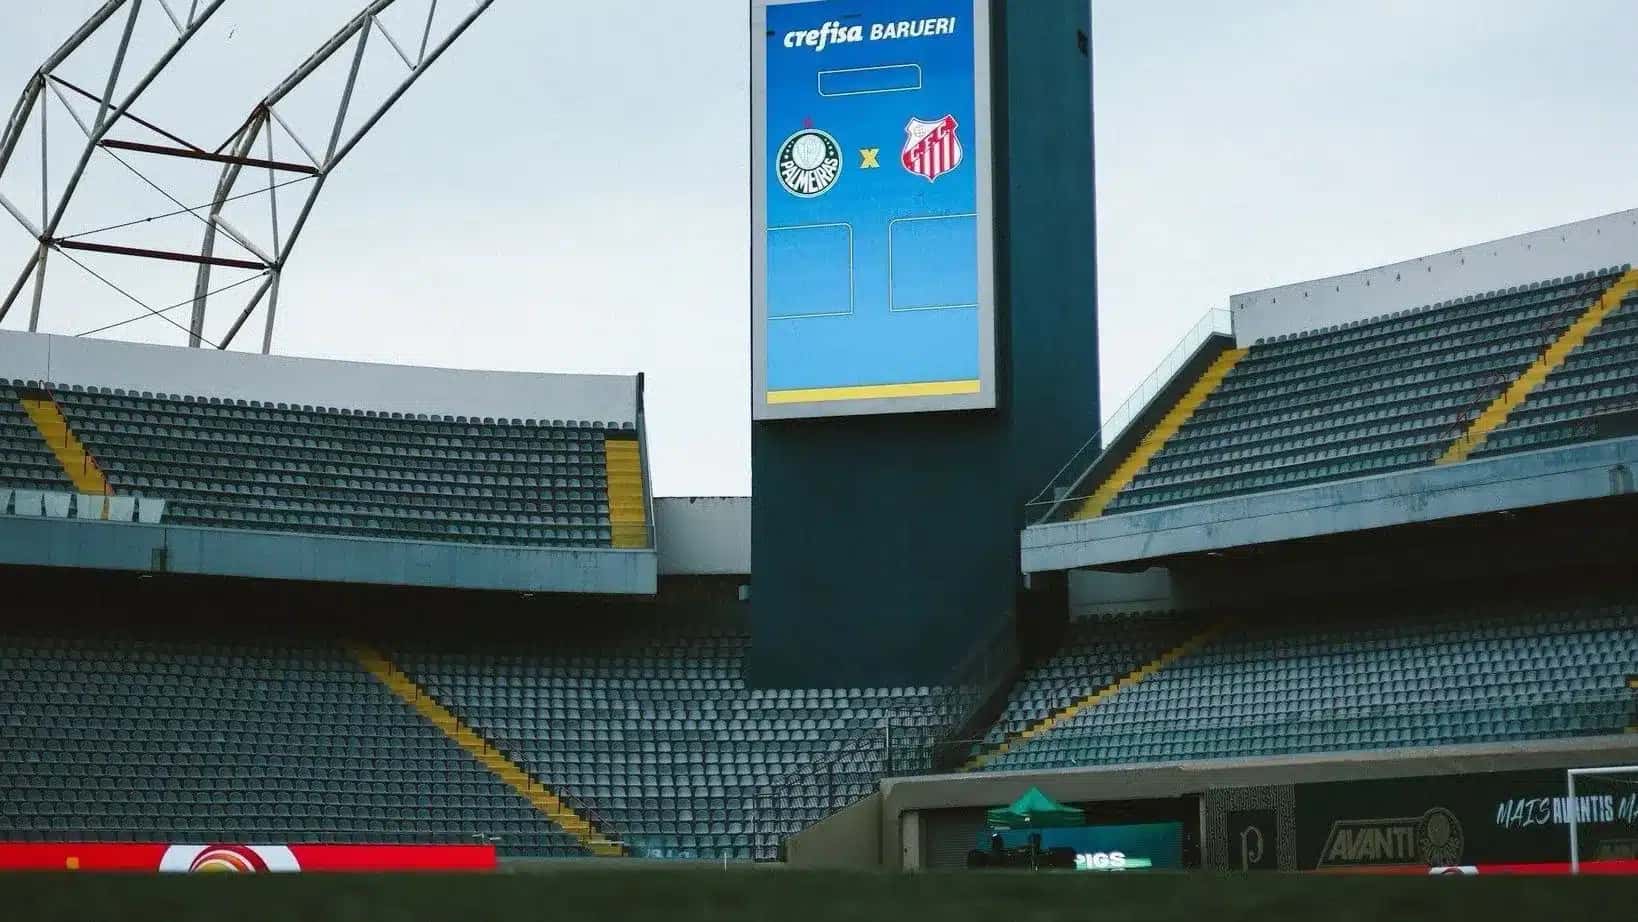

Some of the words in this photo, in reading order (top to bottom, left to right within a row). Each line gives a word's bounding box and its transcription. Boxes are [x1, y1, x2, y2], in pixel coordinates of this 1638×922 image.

[783, 20, 864, 51] crefisa
[869, 16, 956, 41] BARUERI
[780, 157, 839, 194] PALMEIRAS
[1496, 796, 1551, 829] MAIS
[1327, 826, 1416, 861] AVANTI
